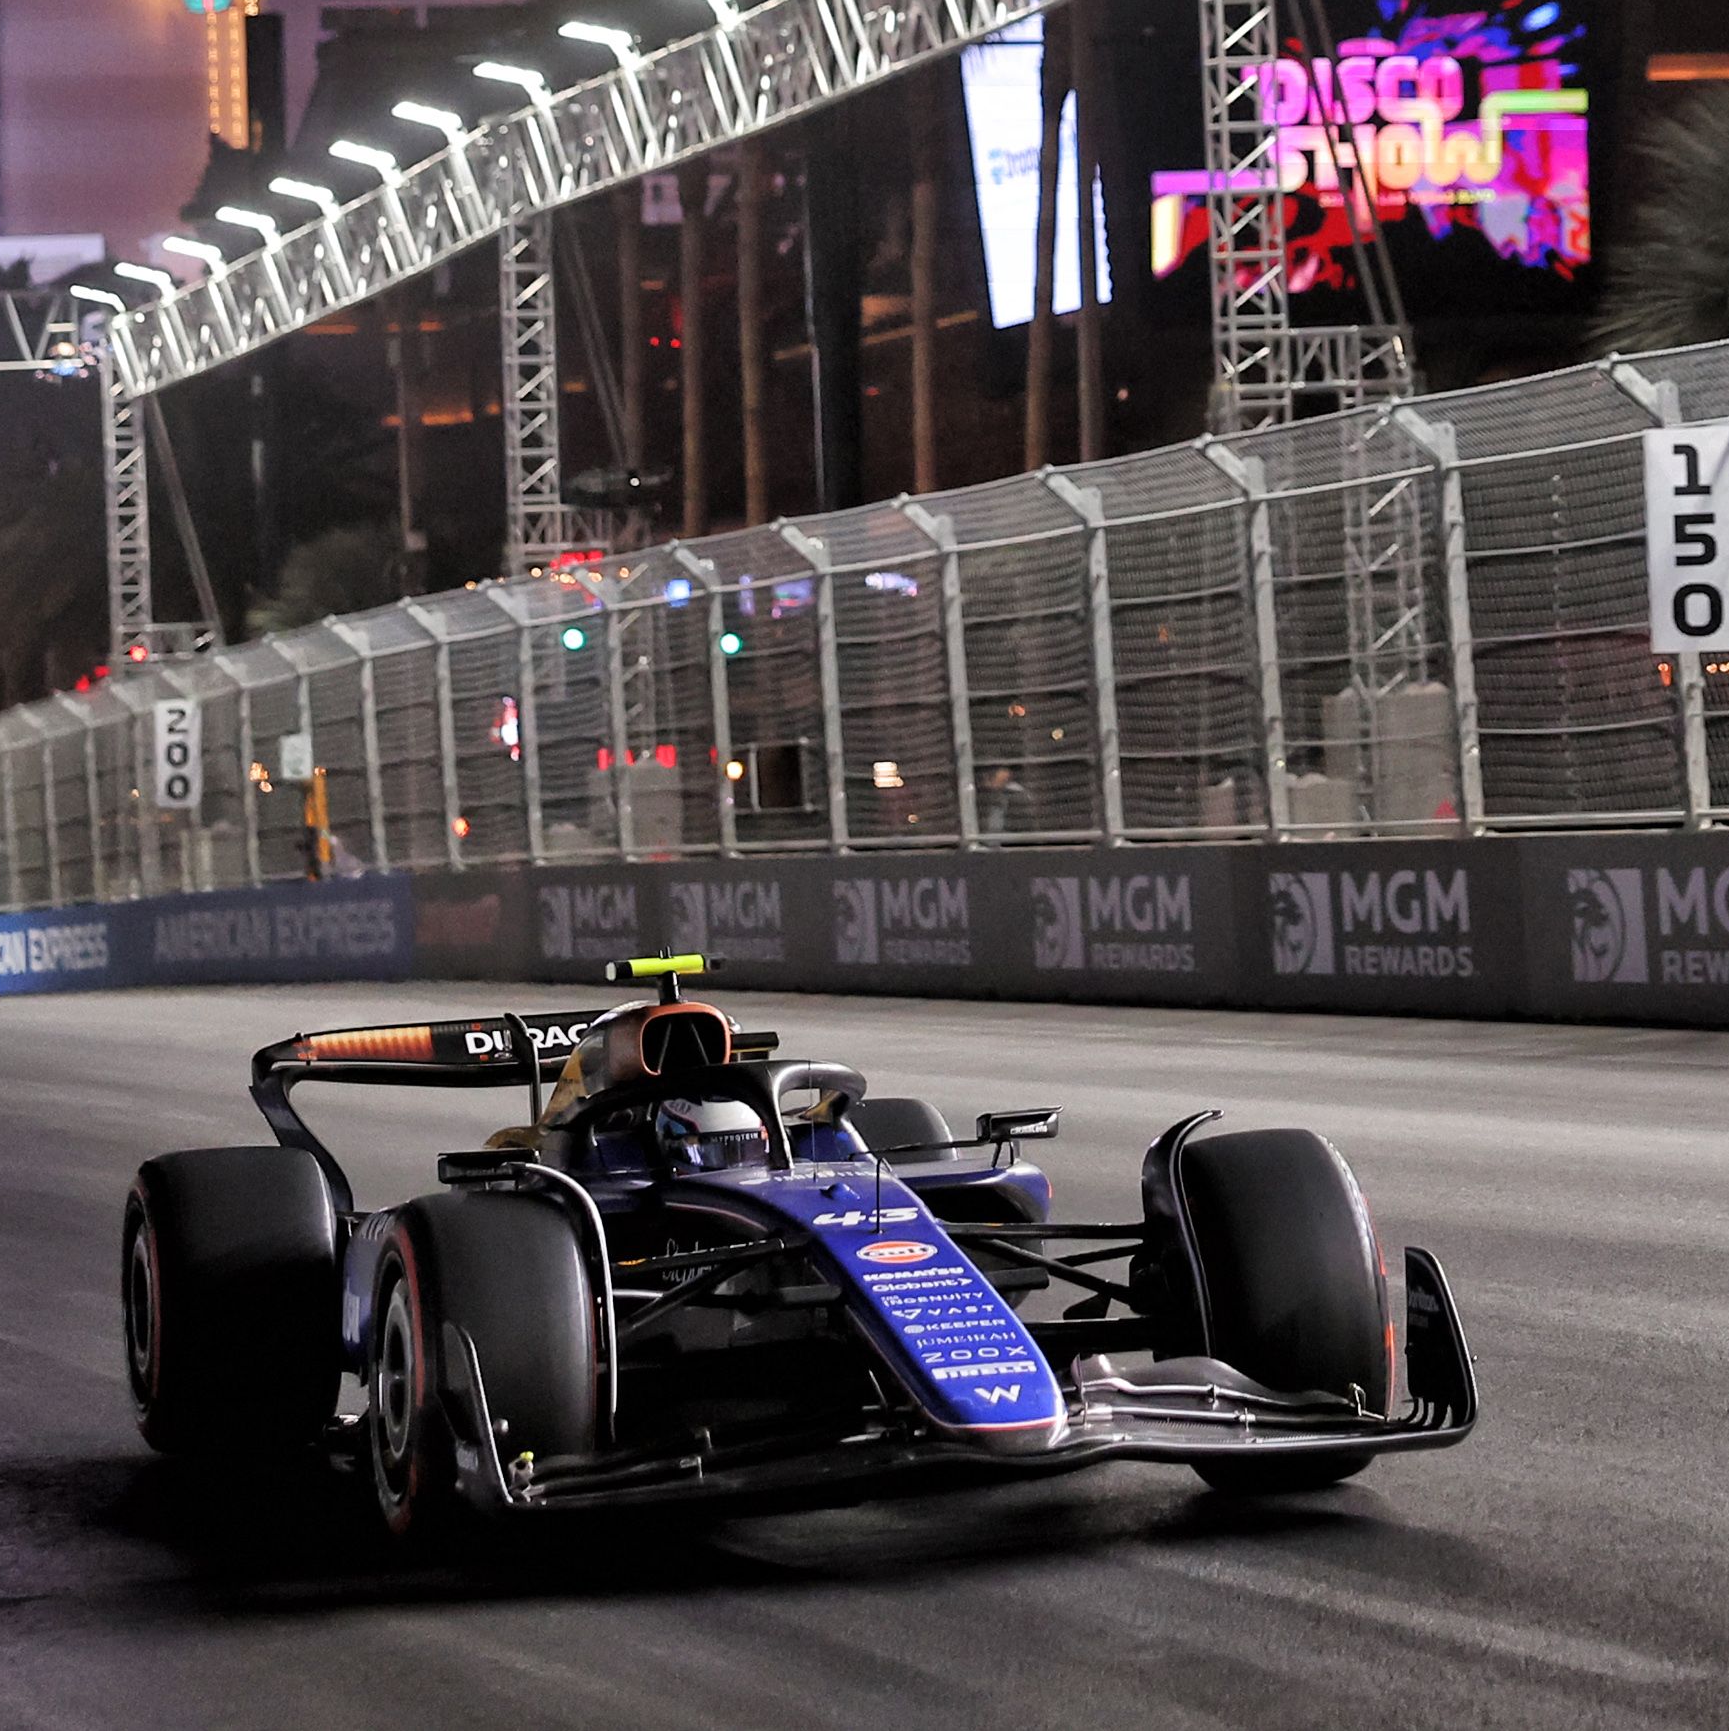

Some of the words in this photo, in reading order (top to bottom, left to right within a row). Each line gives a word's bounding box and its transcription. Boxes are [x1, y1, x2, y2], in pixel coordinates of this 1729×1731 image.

[1254, 55, 1464, 126] DISCO
[1672, 443, 1724, 637] 150
[166, 708, 190, 800] 200
[880, 876, 969, 930] MGM
[1088, 873, 1193, 932] MGM
[1339, 869, 1470, 934] MGM
[1343, 945, 1473, 976] REWARDS
[813, 1207, 919, 1227] 43
[860, 1244, 932, 1259] Gulf
[863, 1266, 965, 1282] KOMATSU
[883, 1291, 984, 1308] INGENUITY
[927, 1304, 995, 1316] VAST
[925, 1318, 1007, 1332] KEEPER
[915, 1331, 1017, 1349] JUMEIRAH
[921, 1345, 1028, 1364] ZOOX
